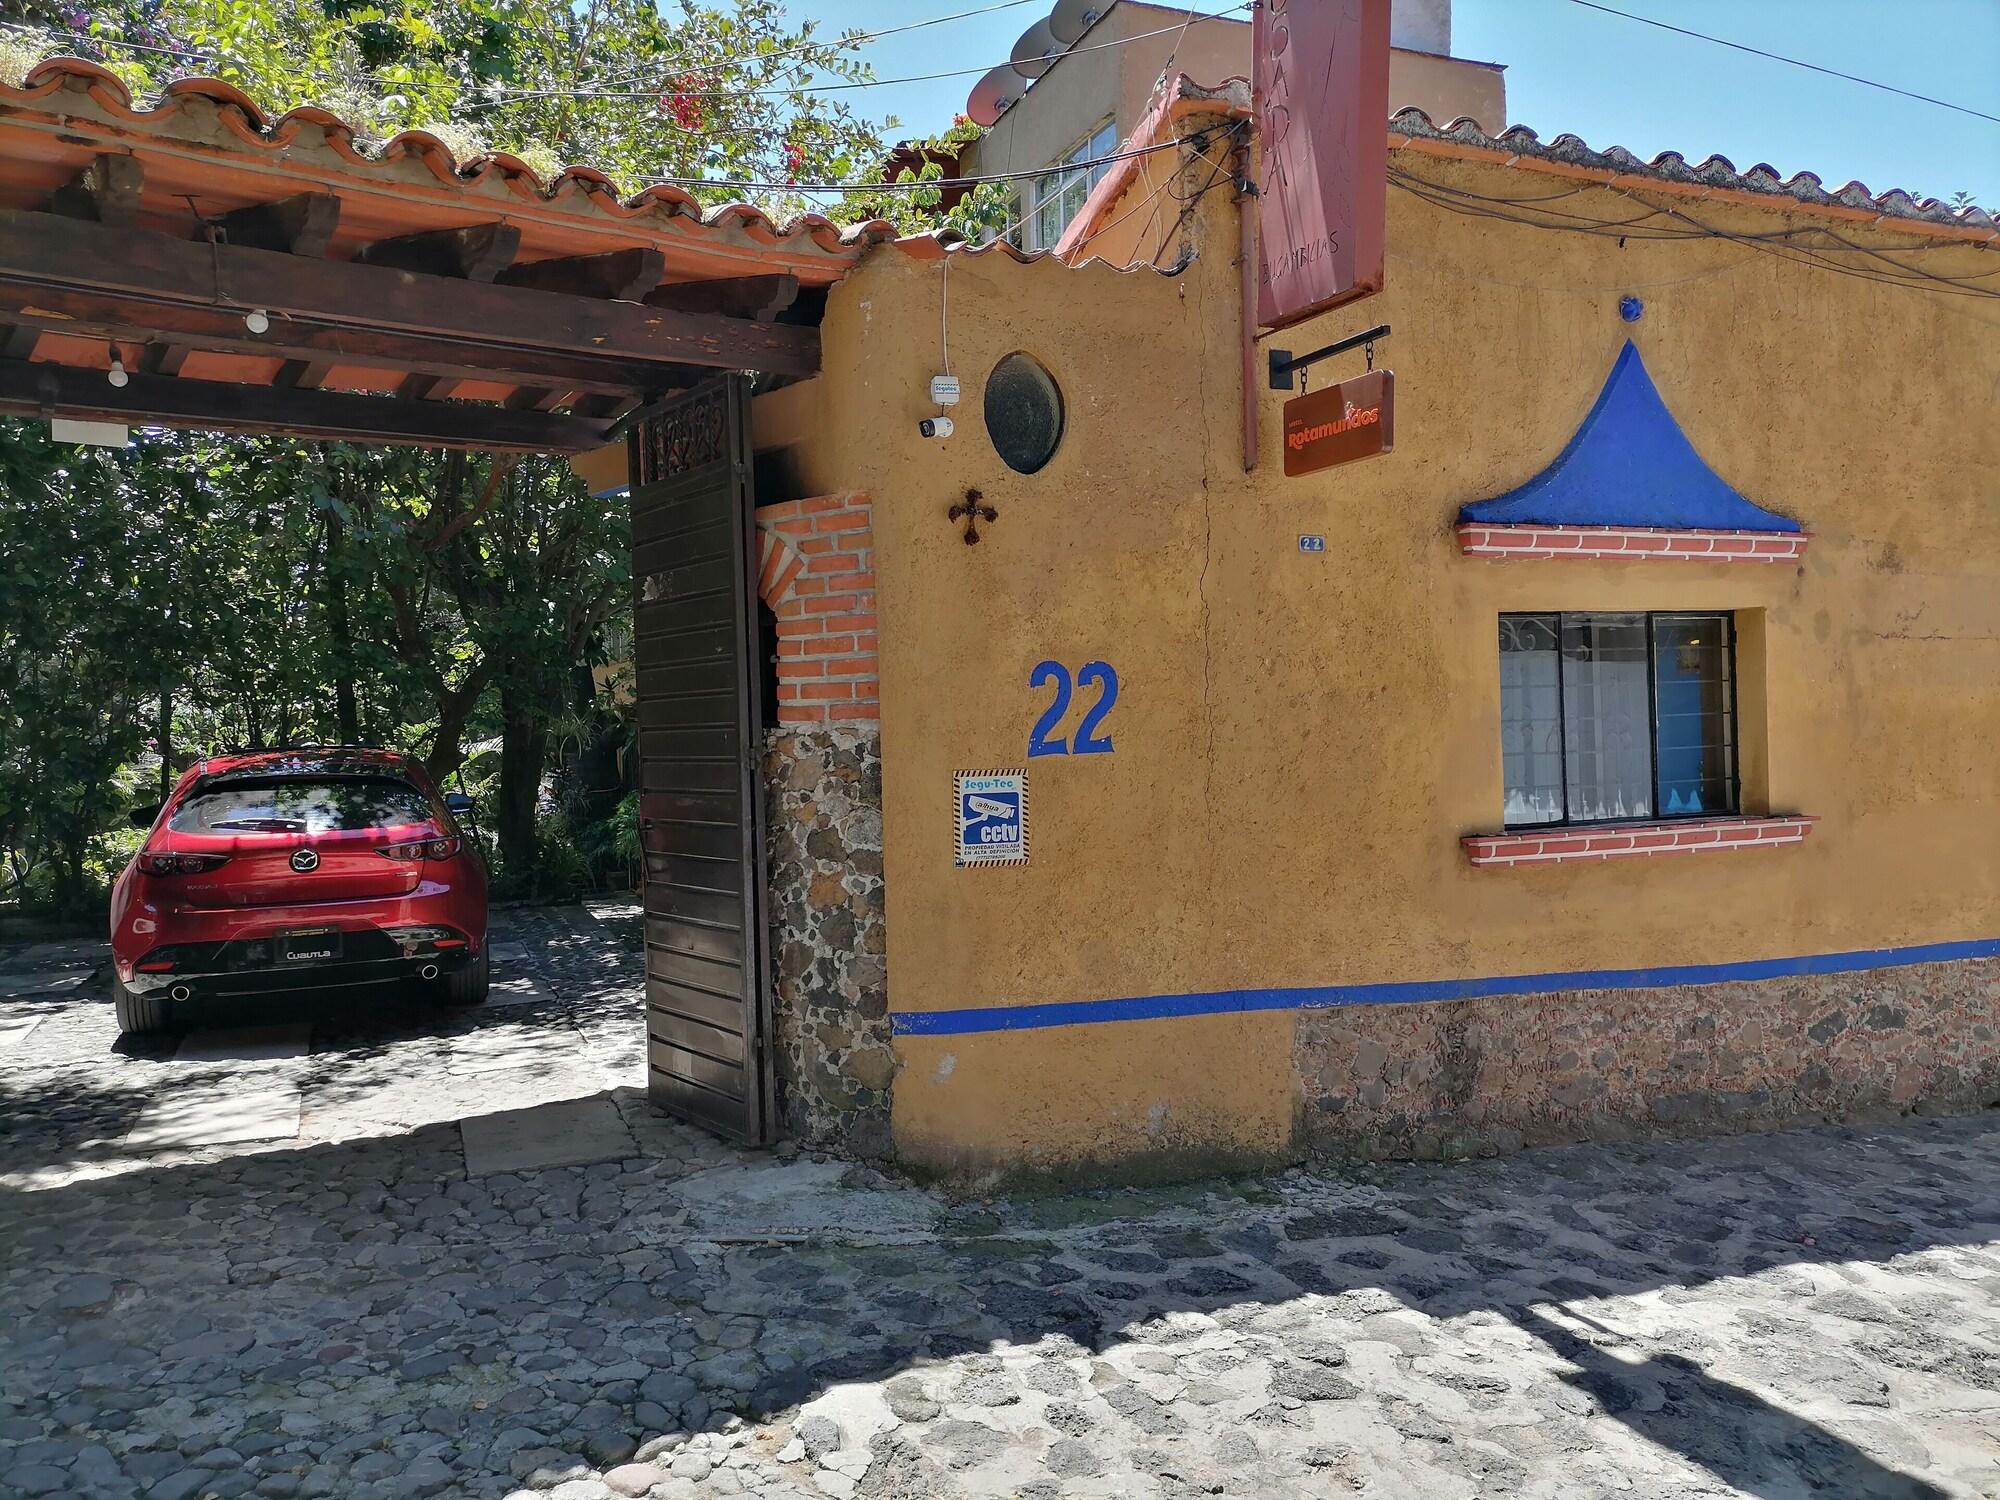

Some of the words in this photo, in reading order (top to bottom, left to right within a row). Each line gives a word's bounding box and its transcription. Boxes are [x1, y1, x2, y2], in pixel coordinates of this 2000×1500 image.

[1264, 0, 1290, 196] SADA
[1288, 407, 1379, 450] Rotamundos
[1303, 537, 1321, 550] 22
[1027, 660, 1119, 758] 22
